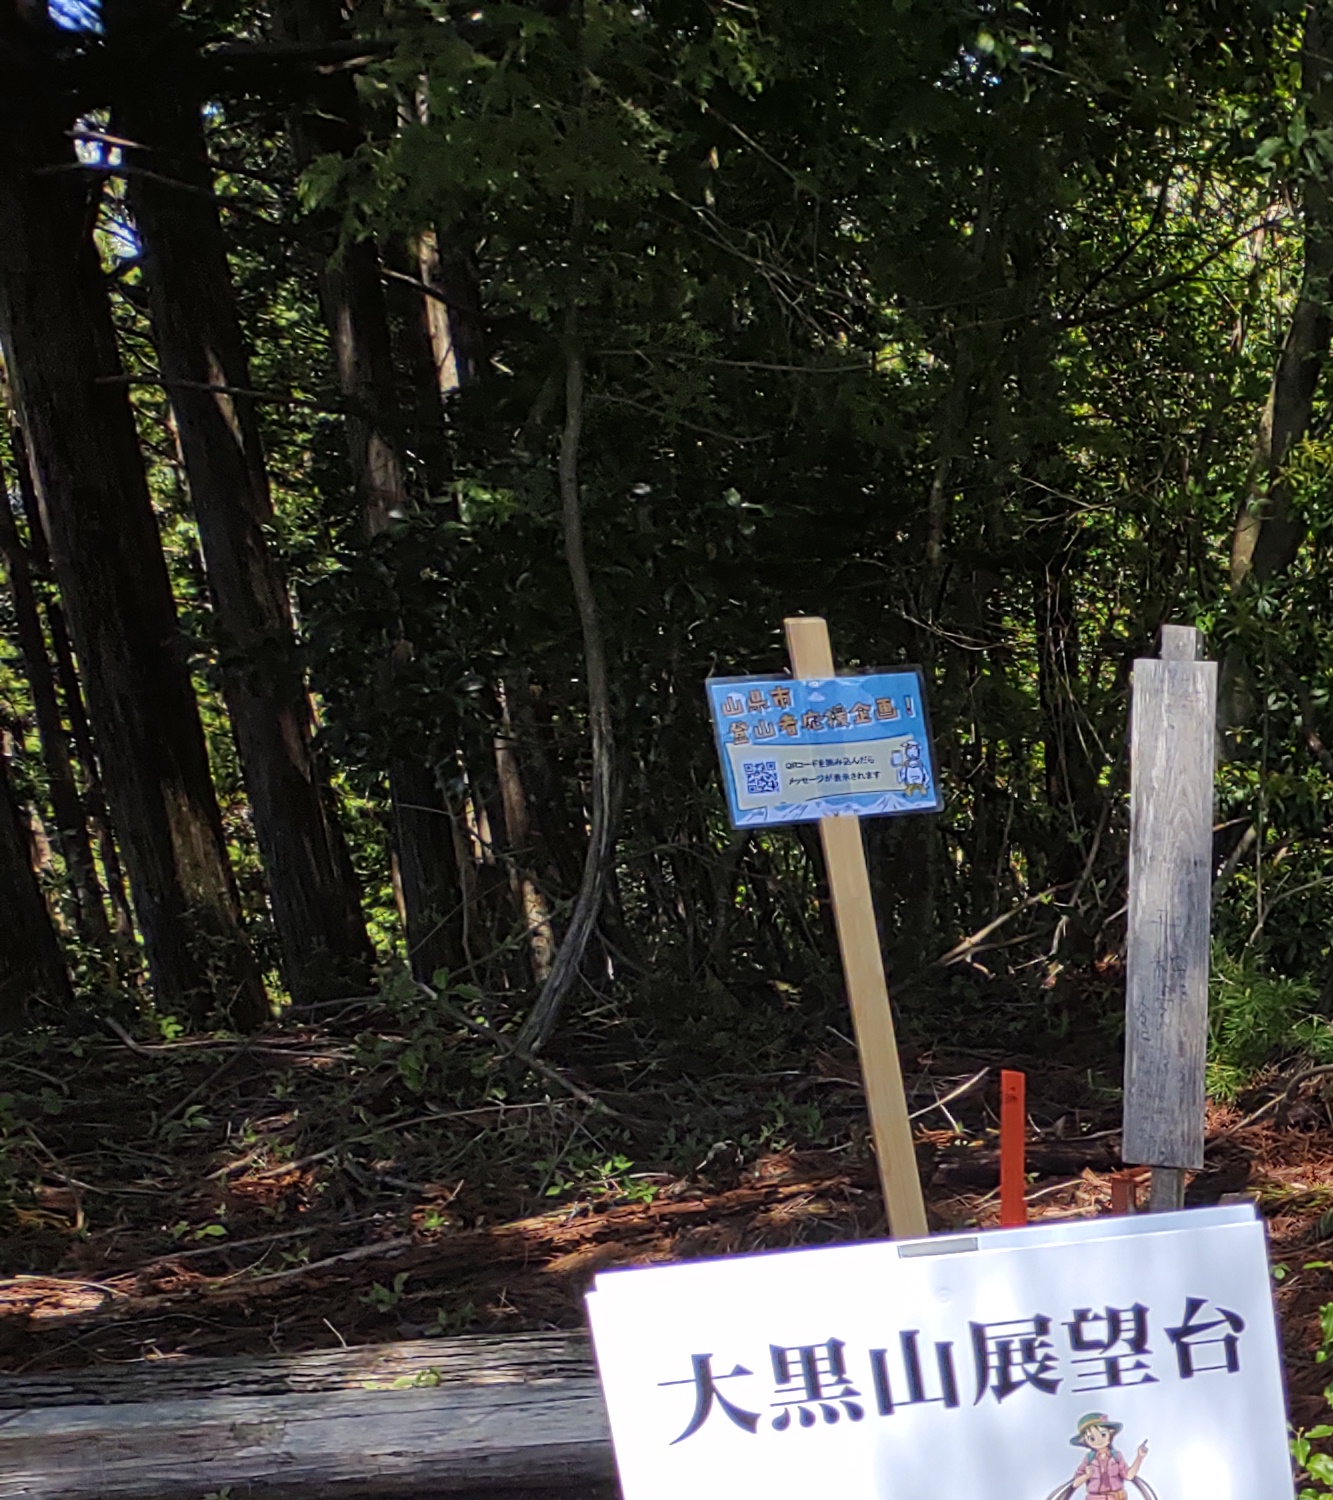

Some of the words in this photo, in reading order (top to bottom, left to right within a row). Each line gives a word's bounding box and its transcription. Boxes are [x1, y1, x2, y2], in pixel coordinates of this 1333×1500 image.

[722, 686, 792, 716] 山県市
[788, 771, 880, 785] メッセージが表示されます
[657, 1296, 1247, 1446] 大黒山展望台
